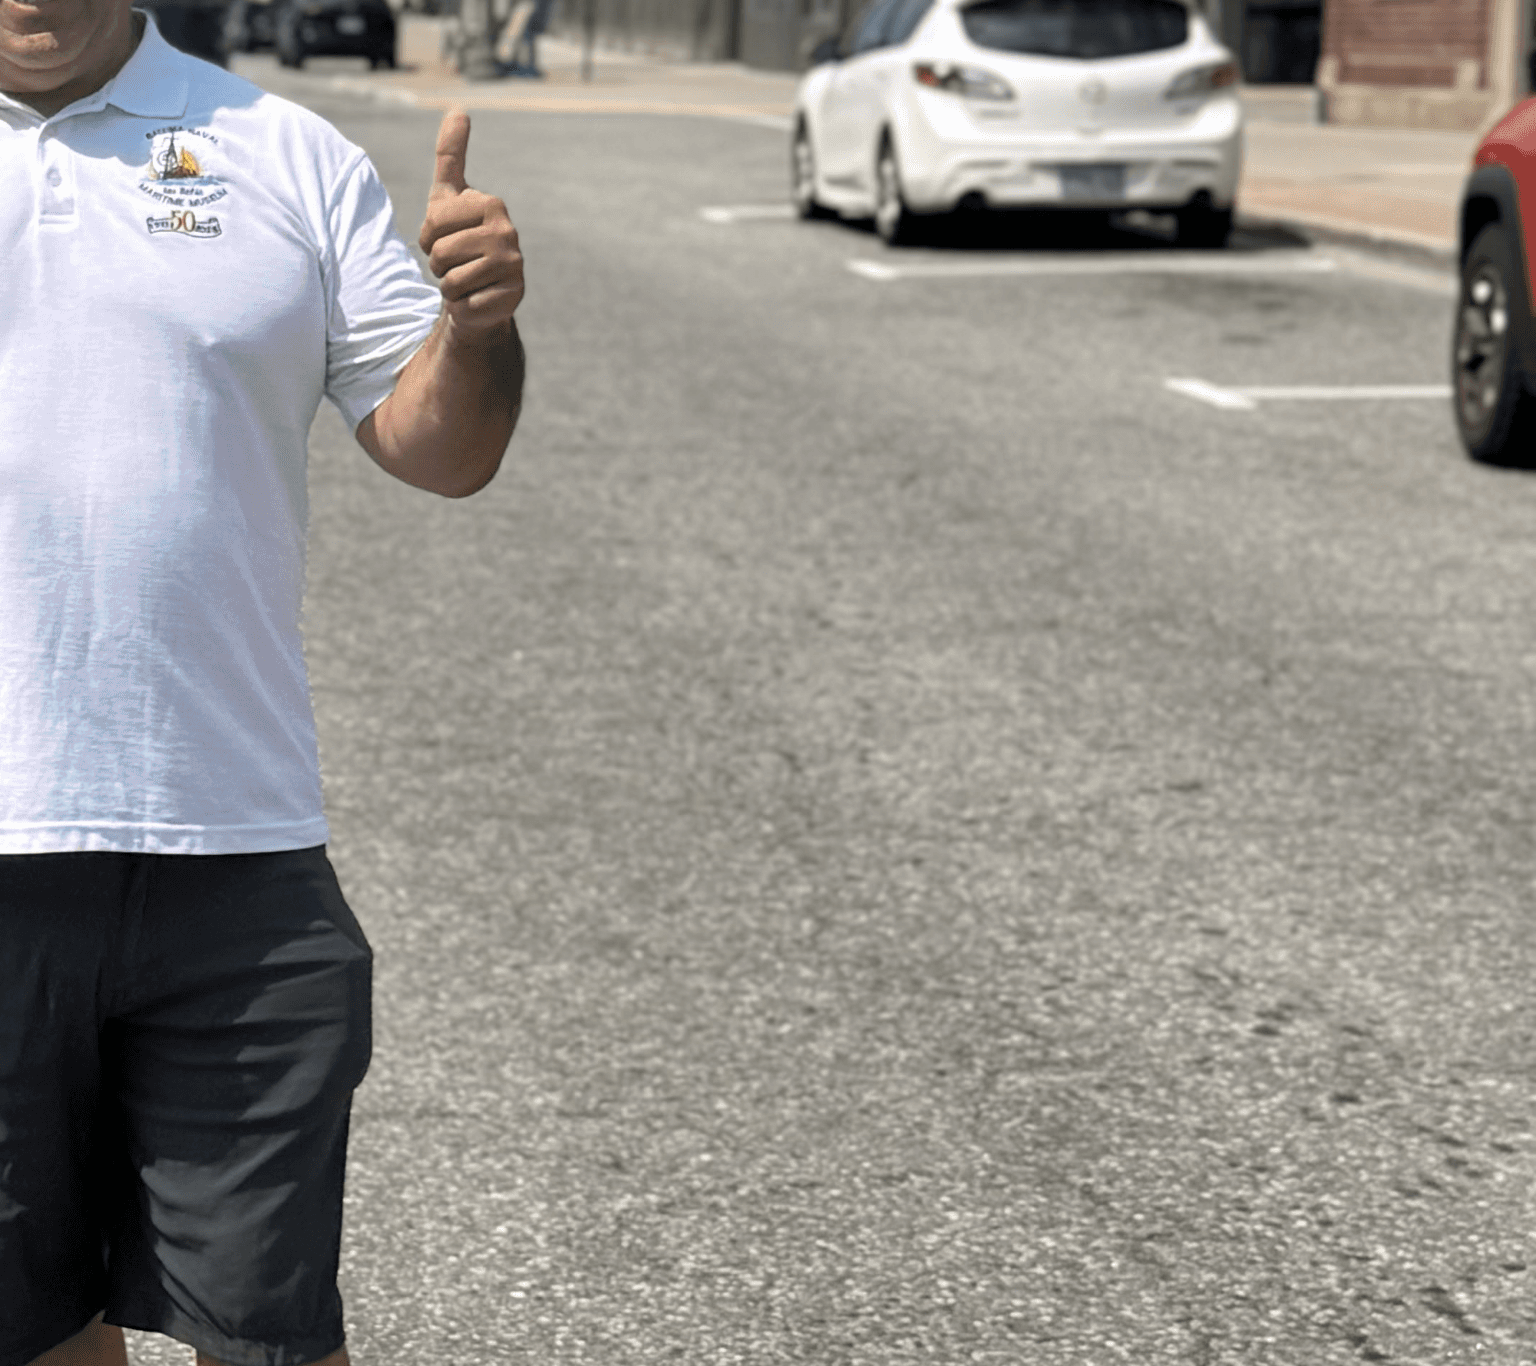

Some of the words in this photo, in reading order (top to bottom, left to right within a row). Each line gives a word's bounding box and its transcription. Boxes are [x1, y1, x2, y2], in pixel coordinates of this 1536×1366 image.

[138, 183, 185, 207] MARITIME
[189, 188, 228, 207] MUSEUM
[171, 210, 195, 232] 50
